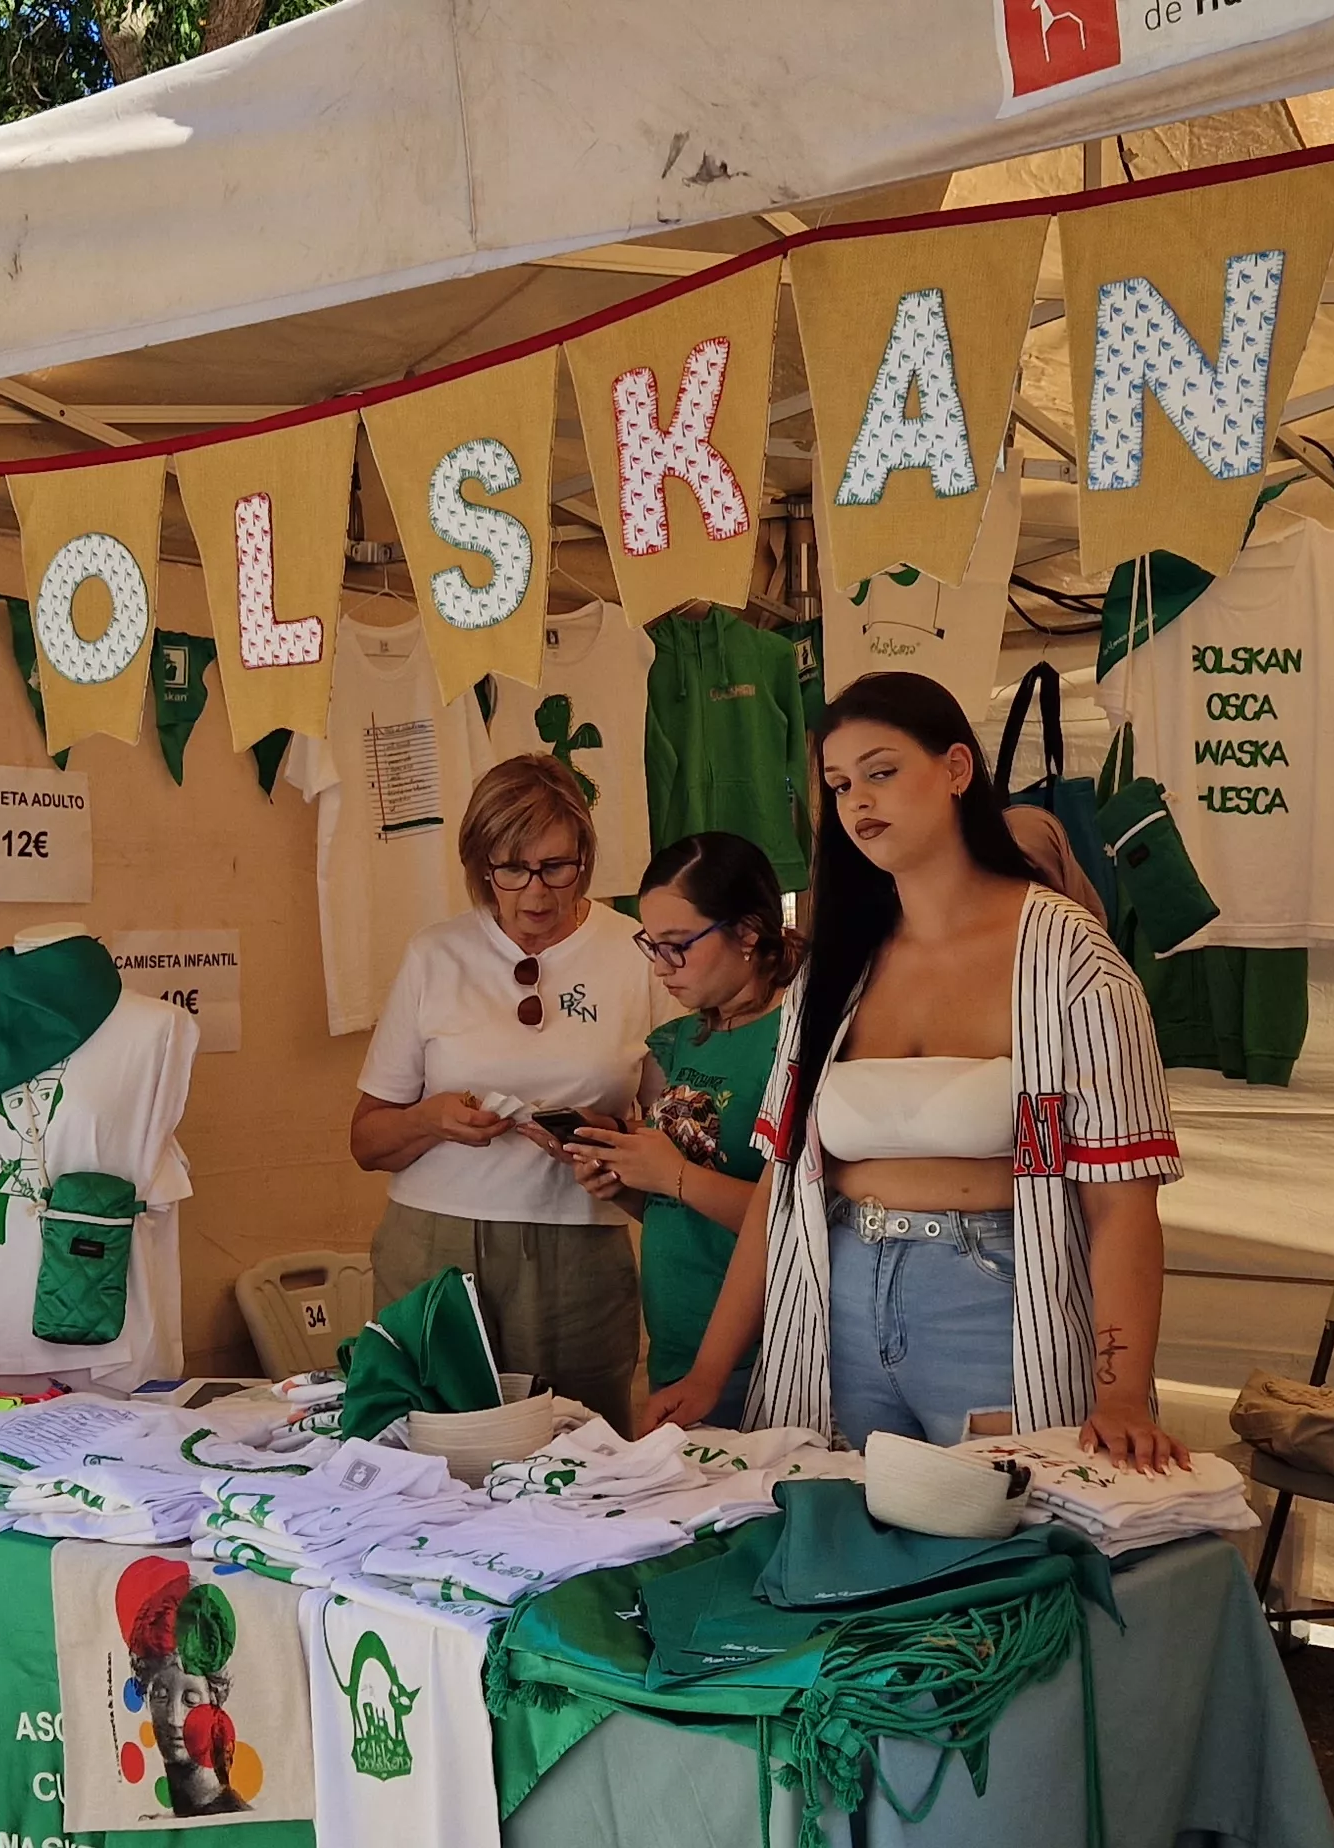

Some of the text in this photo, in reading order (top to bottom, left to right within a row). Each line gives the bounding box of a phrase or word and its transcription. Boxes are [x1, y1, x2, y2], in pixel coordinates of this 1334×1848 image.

[1206, 692, 1278, 721] OSCA
[1195, 739, 1289, 768] WASKA
[31, 794, 85, 810] ADULTO
[1, 830, 49, 858] 12€
[114, 953, 238, 970] CAMISETA INFANTIL
[305, 1304, 327, 1328] 34
